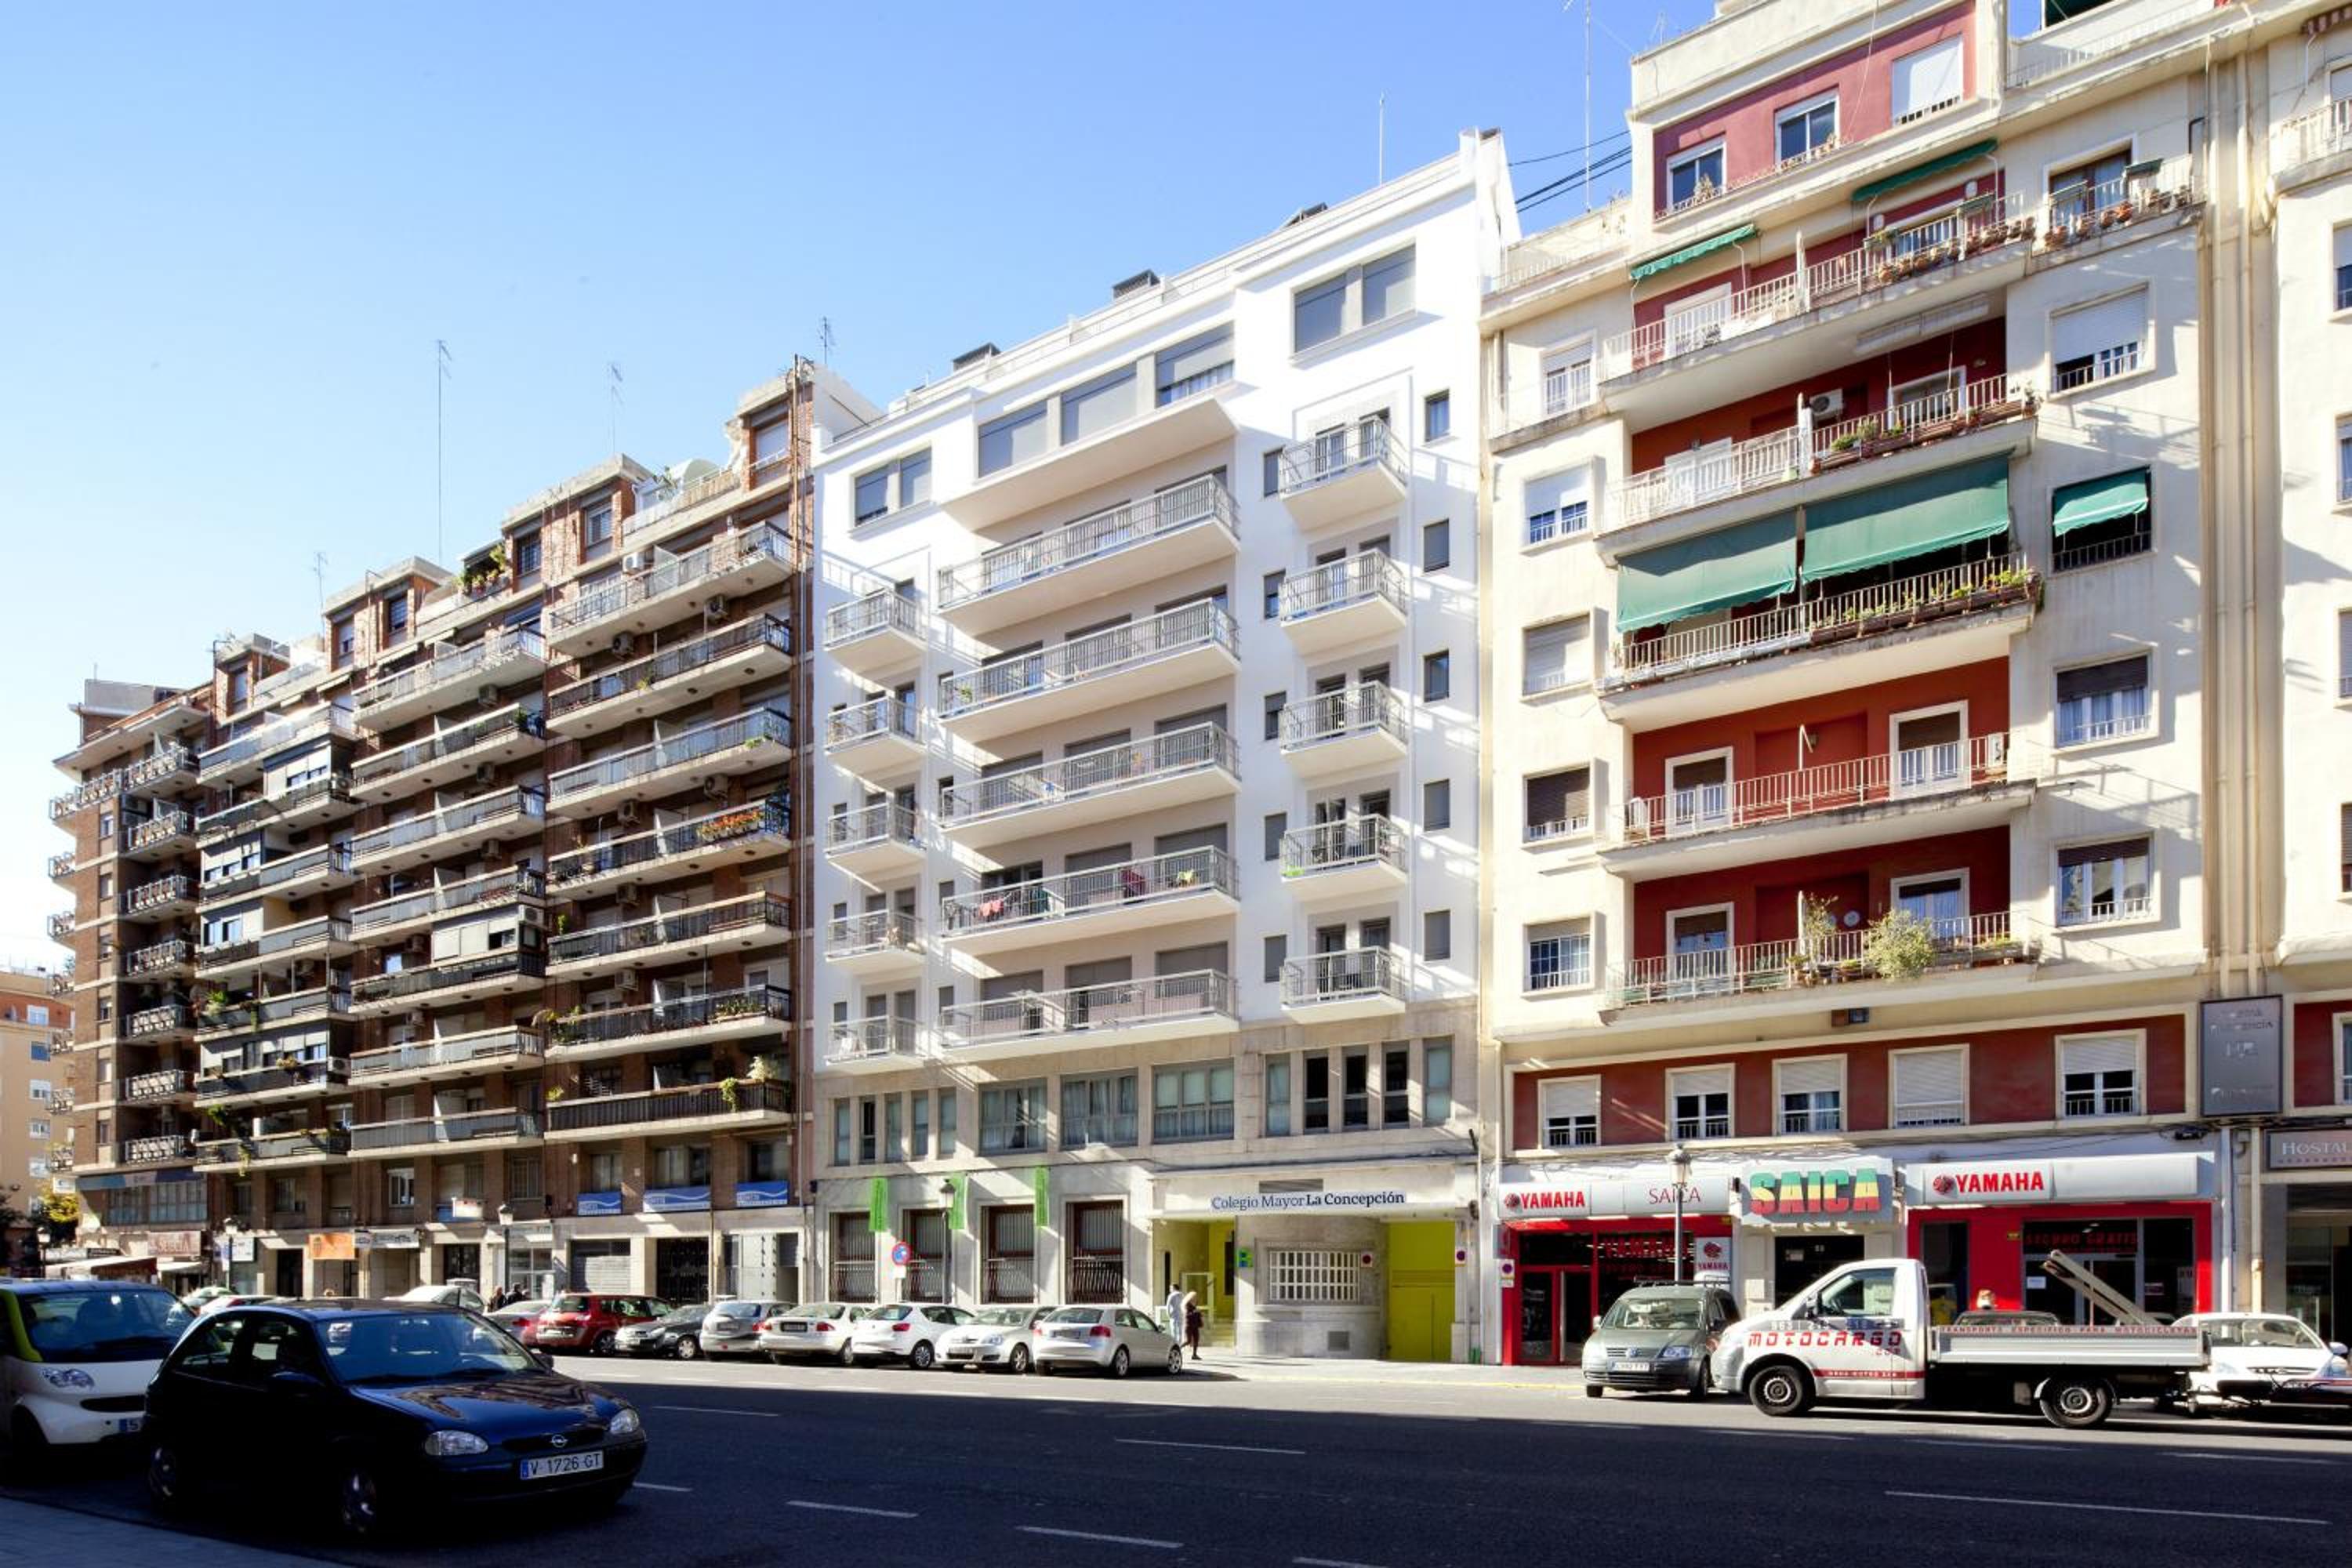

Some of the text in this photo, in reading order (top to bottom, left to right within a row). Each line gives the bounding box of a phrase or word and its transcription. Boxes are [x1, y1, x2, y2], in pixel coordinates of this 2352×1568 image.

[1749, 1167, 1881, 1214] SAICA
[1955, 1171, 2045, 1193] YAMAHA
[1211, 1191, 1405, 1211] Colegio Mayor La Concepción
[1520, 1190, 1586, 1209] YAMAHA
[1748, 1330, 1902, 1348] MOTOCARGO
